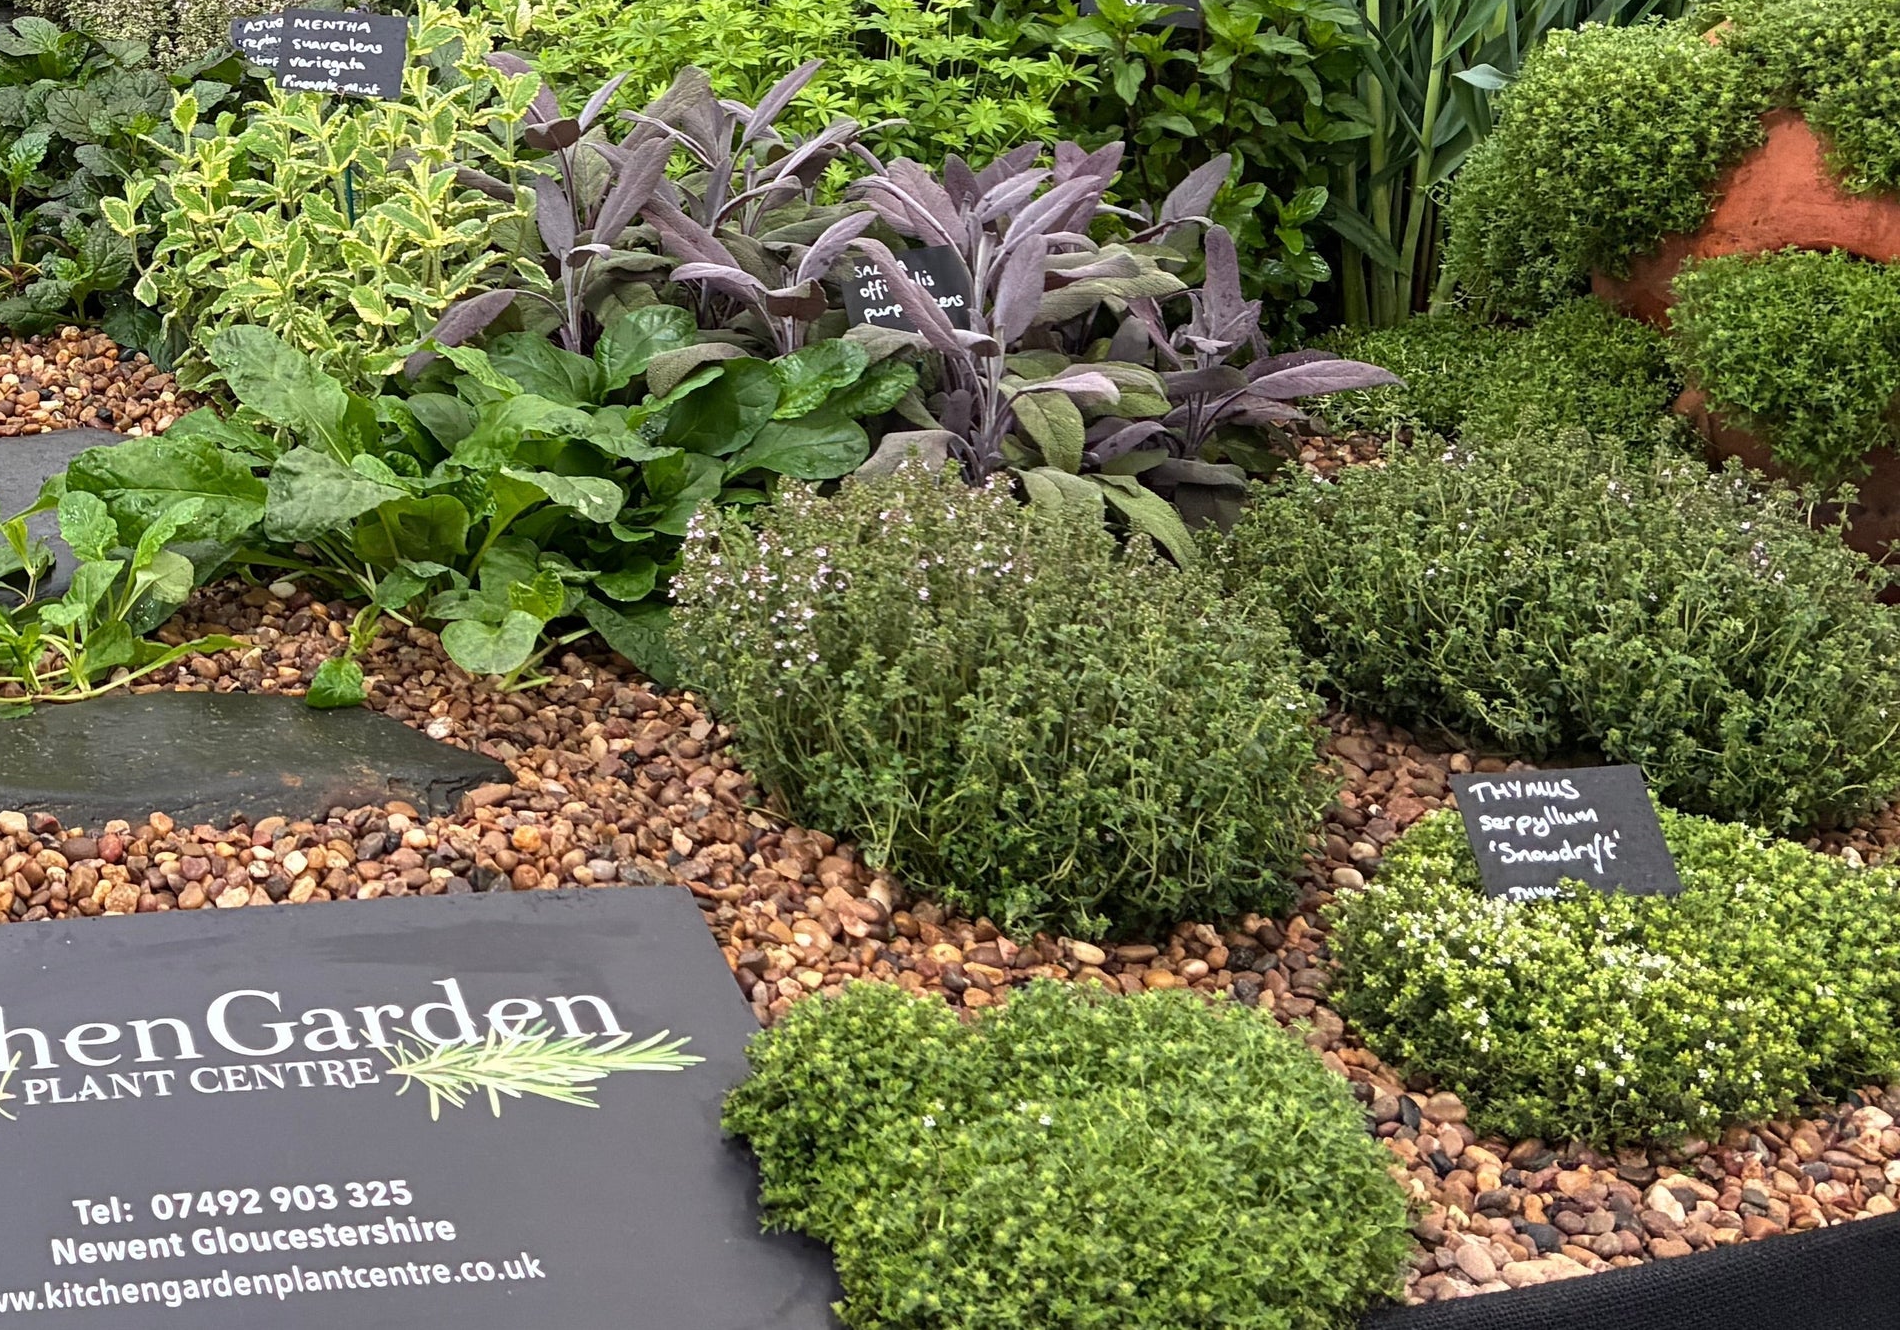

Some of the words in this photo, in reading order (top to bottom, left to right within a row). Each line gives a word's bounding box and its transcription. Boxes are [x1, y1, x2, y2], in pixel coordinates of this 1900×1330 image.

[293, 18, 372, 34] MENTHA
[291, 37, 384, 54] suaveolens
[1467, 778, 1581, 803] THYMUS
[1478, 805, 1599, 838] serpyllum
[21, 1069, 175, 1107] PLANT
[189, 1057, 381, 1094] CENTRE
[72, 1196, 135, 1226] Tel:
[150, 1187, 263, 1222] 07492
[270, 1184, 339, 1214] 903
[347, 1179, 413, 1207] 325
[51, 1233, 183, 1266] Newent
[191, 1216, 457, 1258] Gloucestershire
